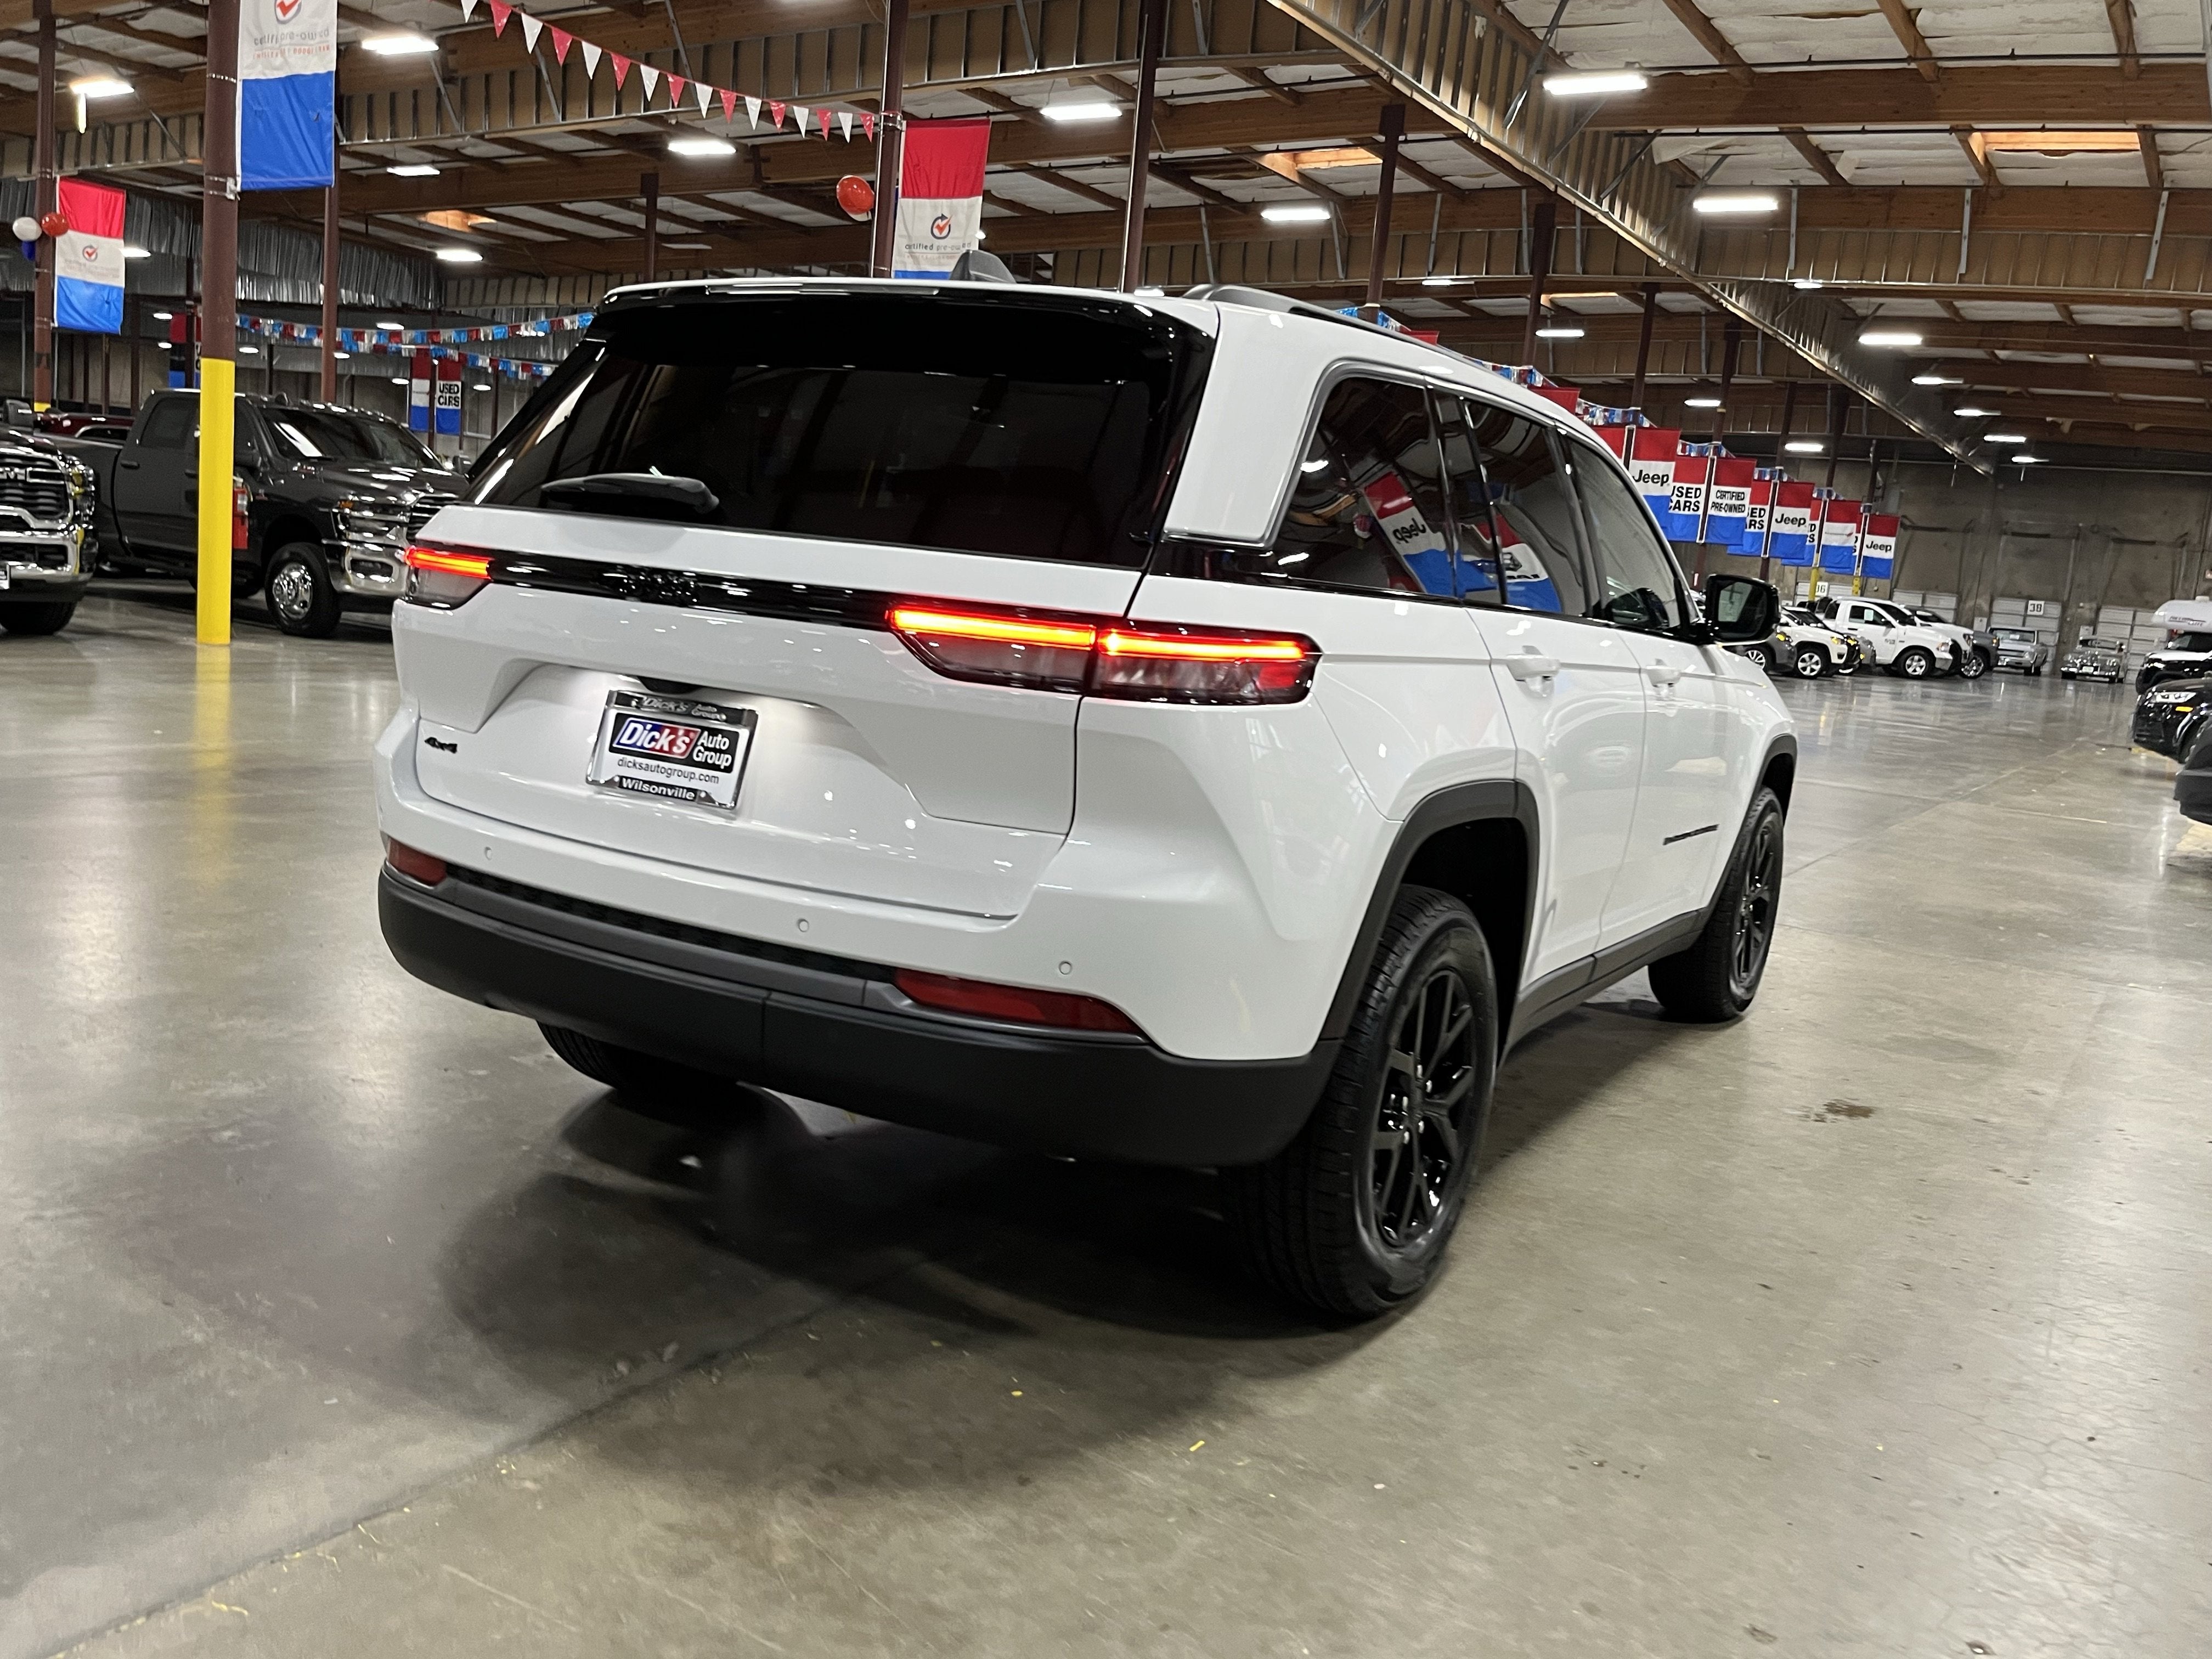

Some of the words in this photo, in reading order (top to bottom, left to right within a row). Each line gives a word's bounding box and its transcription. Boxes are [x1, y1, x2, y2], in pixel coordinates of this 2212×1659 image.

[936, 241, 971, 251] pre-owed
[439, 382, 460, 394] USED
[1633, 470, 1669, 487] Jeep
[1716, 490, 1745, 500] CERTIFIED
[1711, 501, 1745, 513] PRE-OWNED
[1775, 514, 1806, 527] Jeep
[1866, 541, 1892, 552] Jeep
[619, 722, 691, 754] Dick's
[697, 731, 730, 750] Auto
[692, 746, 732, 769] Group
[617, 757, 719, 784] dicksautogroup.com
[622, 777, 695, 800] Wilsonville
